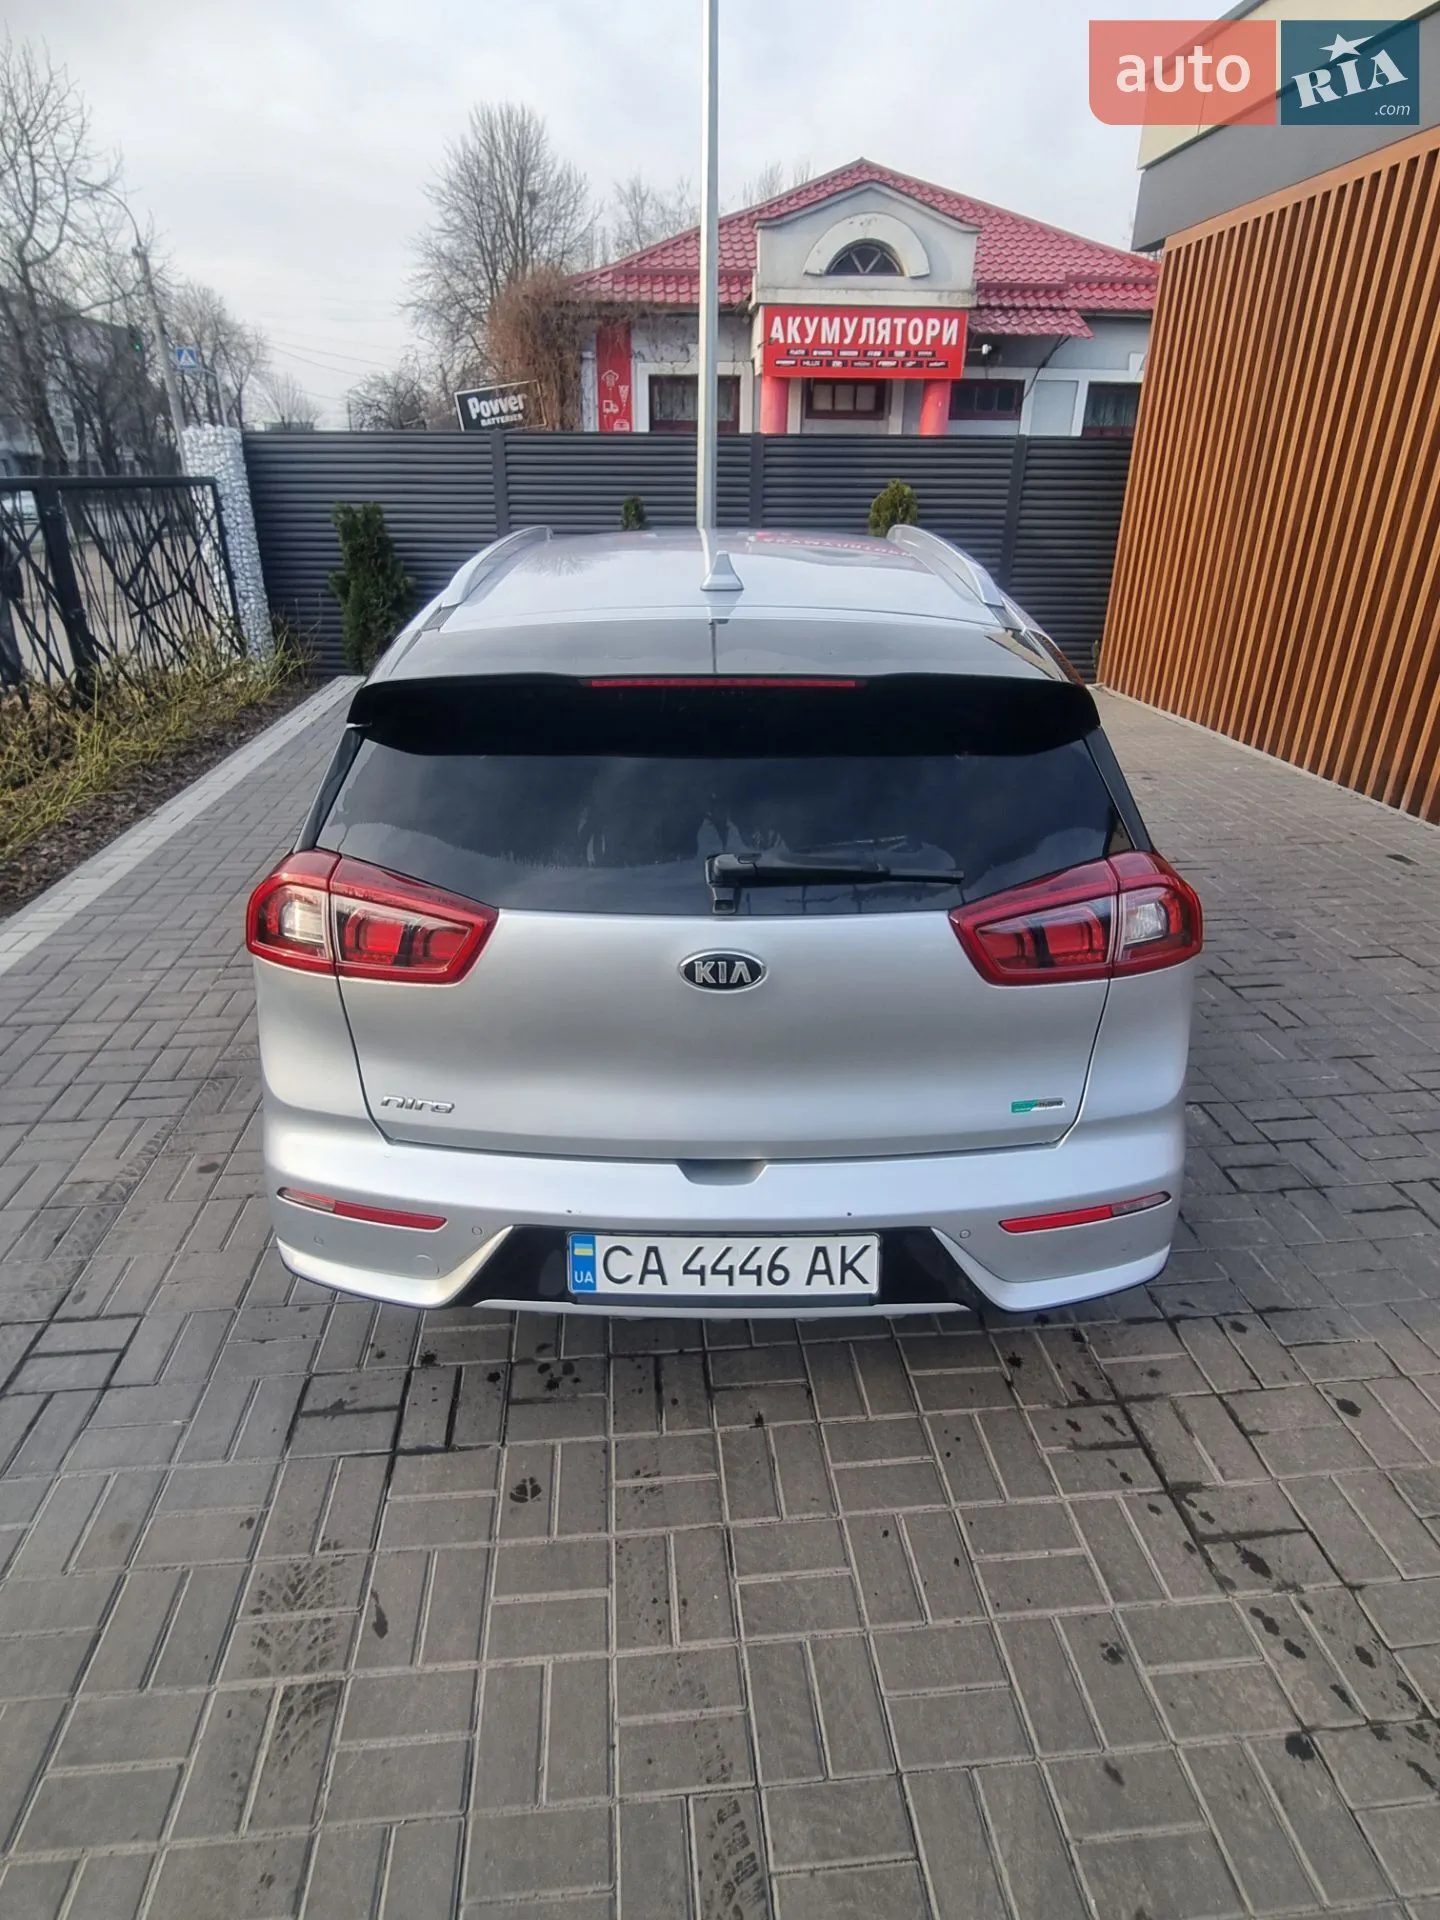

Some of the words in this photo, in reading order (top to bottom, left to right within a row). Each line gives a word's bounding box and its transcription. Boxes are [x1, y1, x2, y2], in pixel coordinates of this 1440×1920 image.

[770, 315, 959, 346] АКУМУЛЯТОРИ
[693, 961, 753, 984] KIA
[574, 1271, 595, 1284] UA
[602, 1244, 669, 1286] CA
[681, 1245, 791, 1287] 4446
[804, 1244, 872, 1286] AK
